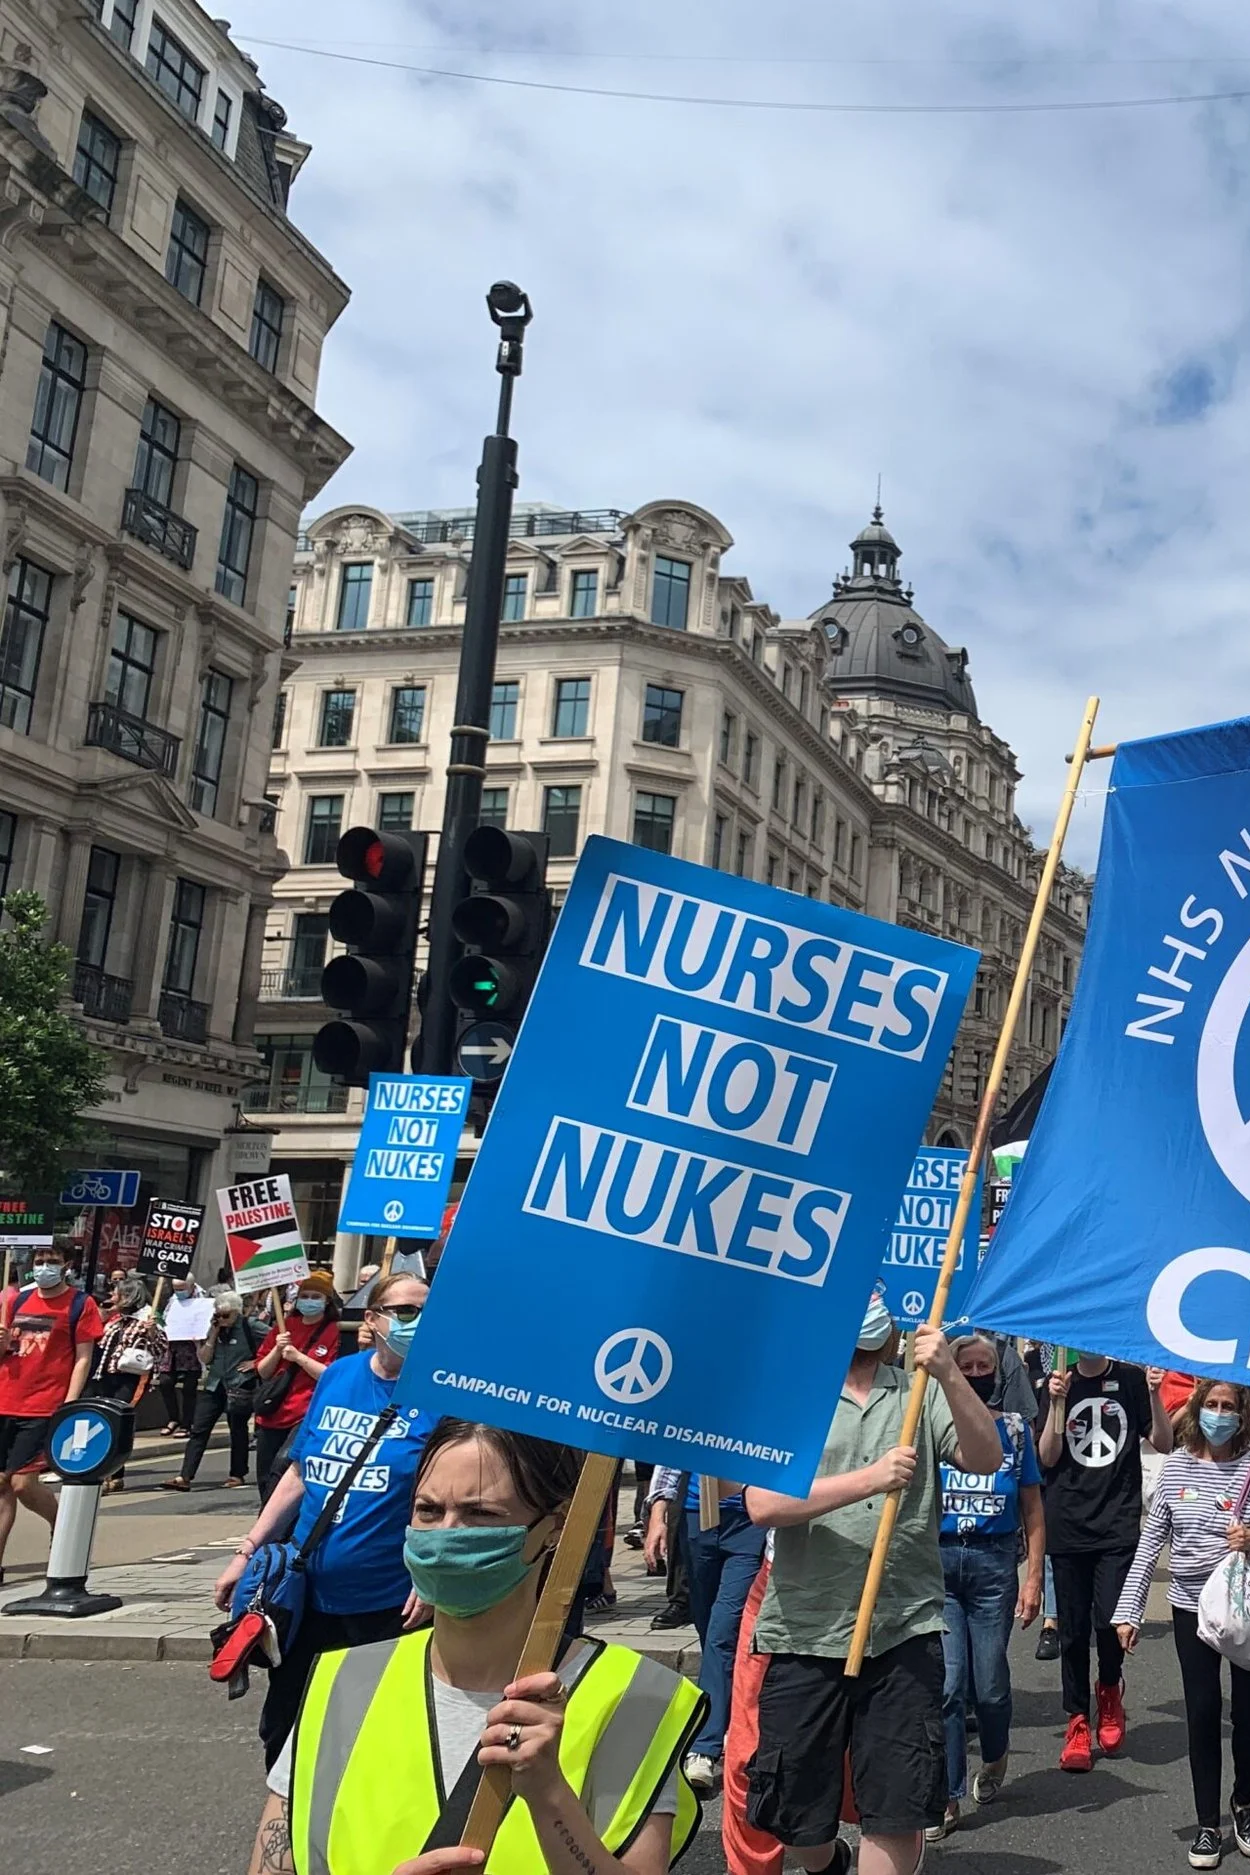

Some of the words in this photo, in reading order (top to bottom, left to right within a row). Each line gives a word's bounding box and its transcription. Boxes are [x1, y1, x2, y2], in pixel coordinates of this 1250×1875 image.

[590, 880, 941, 1055] NURSES
[1125, 894, 1224, 1045] NHS
[163, 1073, 192, 1088] REGENT
[195, 1081, 222, 1094] STREET
[377, 1083, 463, 1112] NURSES
[633, 1024, 830, 1147] NOT
[390, 1118, 437, 1145] NOT
[367, 1151, 443, 1180] NUKES
[913, 1159, 968, 1190] RSE
[228, 1179, 281, 1212] FREE
[529, 1123, 842, 1279] NUKES
[0, 1213, 45, 1225] ESTINE
[150, 1213, 200, 1234] STOP
[225, 1202, 292, 1230] PALESTINE
[145, 1238, 162, 1249] WAR
[163, 1241, 193, 1254] CRIMES
[147, 1227, 196, 1246] ISRAEL'S
[142, 1246, 155, 1258] IN
[157, 1250, 190, 1265] GAZA
[432, 1369, 532, 1405] CAMPAIGN
[535, 1394, 573, 1416] FOR
[576, 1405, 660, 1436] NUCLEAR
[662, 1424, 795, 1466] DISARMAMENT
[306, 1459, 389, 1490] NUES
